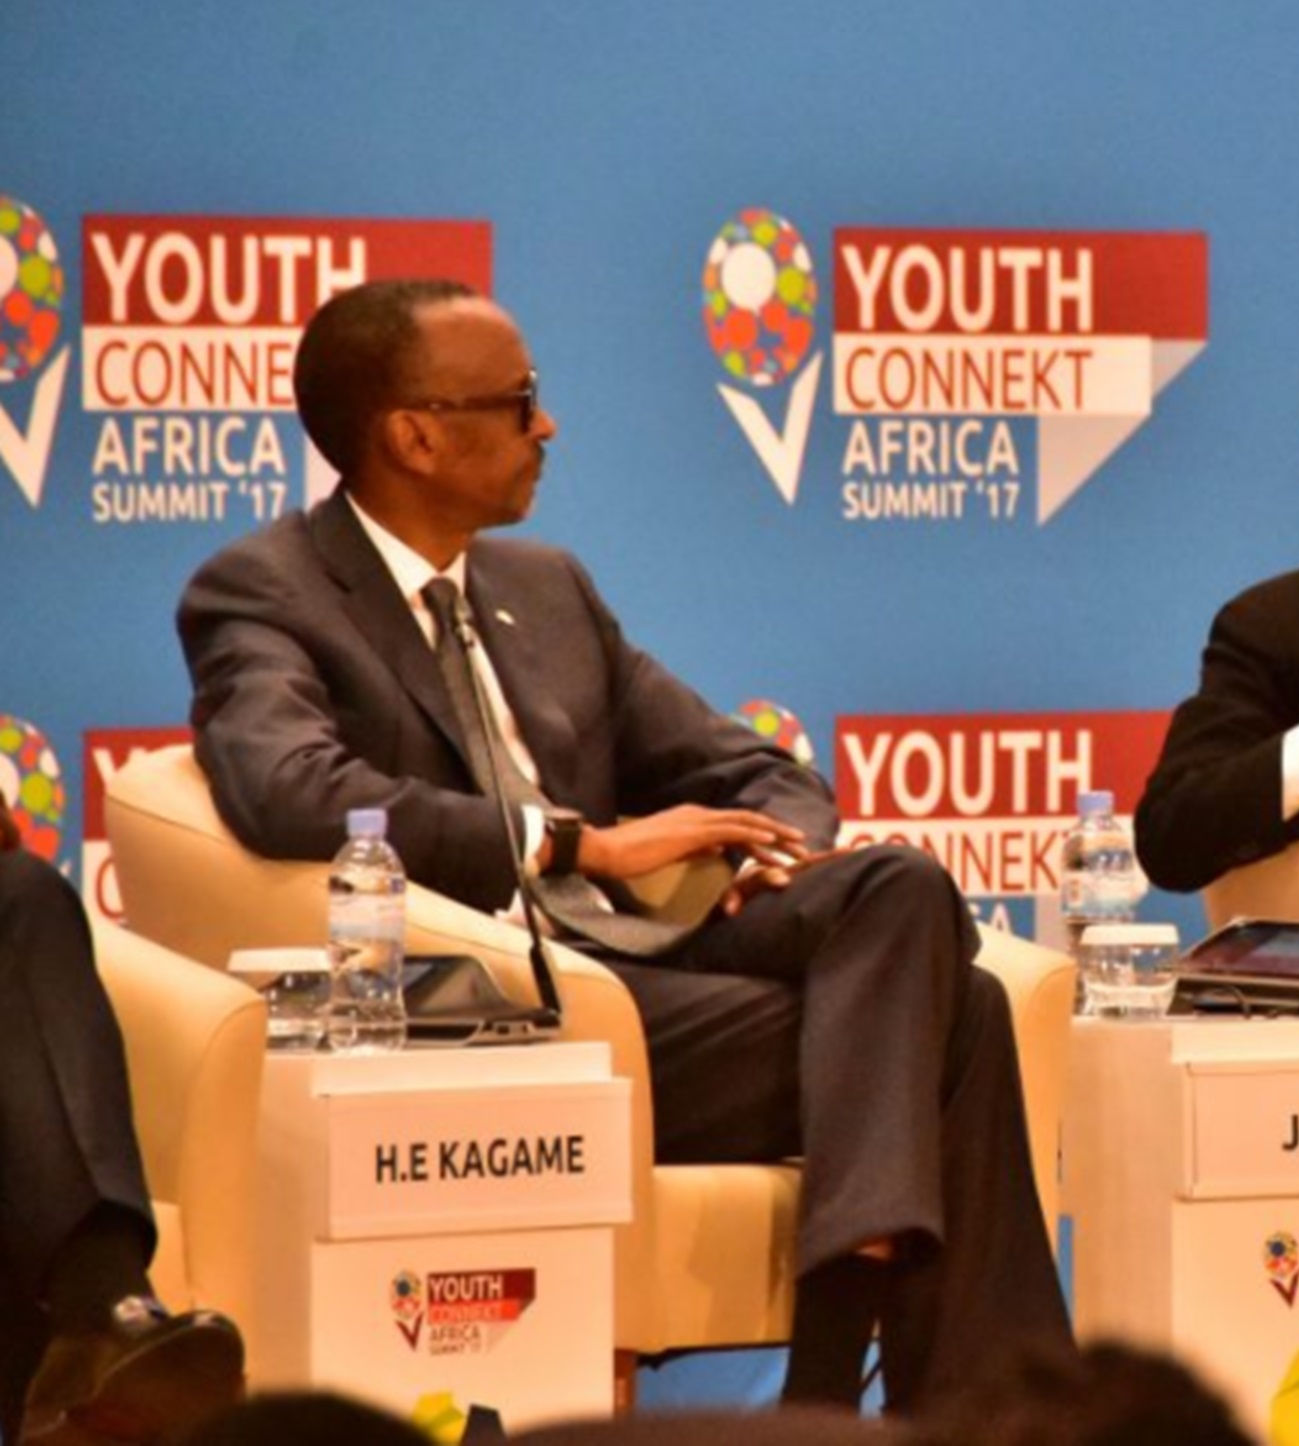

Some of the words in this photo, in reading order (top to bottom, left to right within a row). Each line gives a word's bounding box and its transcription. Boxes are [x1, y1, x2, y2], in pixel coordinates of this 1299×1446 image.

[91, 233, 367, 324] YOUTH
[842, 245, 1093, 332] YOUTH
[95, 340, 295, 406] CONNE
[845, 347, 1093, 411] CONNEKT
[92, 418, 286, 475] AFRICA
[842, 420, 1019, 475] AFRICA
[92, 482, 229, 522] SUMMIT
[238, 482, 286, 520] '17
[842, 482, 967, 519] SUMMIT
[976, 482, 1019, 518] '17
[843, 730, 1092, 817] YOUTH
[375, 1143, 428, 1184] H.E
[438, 1135, 585, 1180] KAGAME
[430, 1275, 504, 1302] YOUTH
